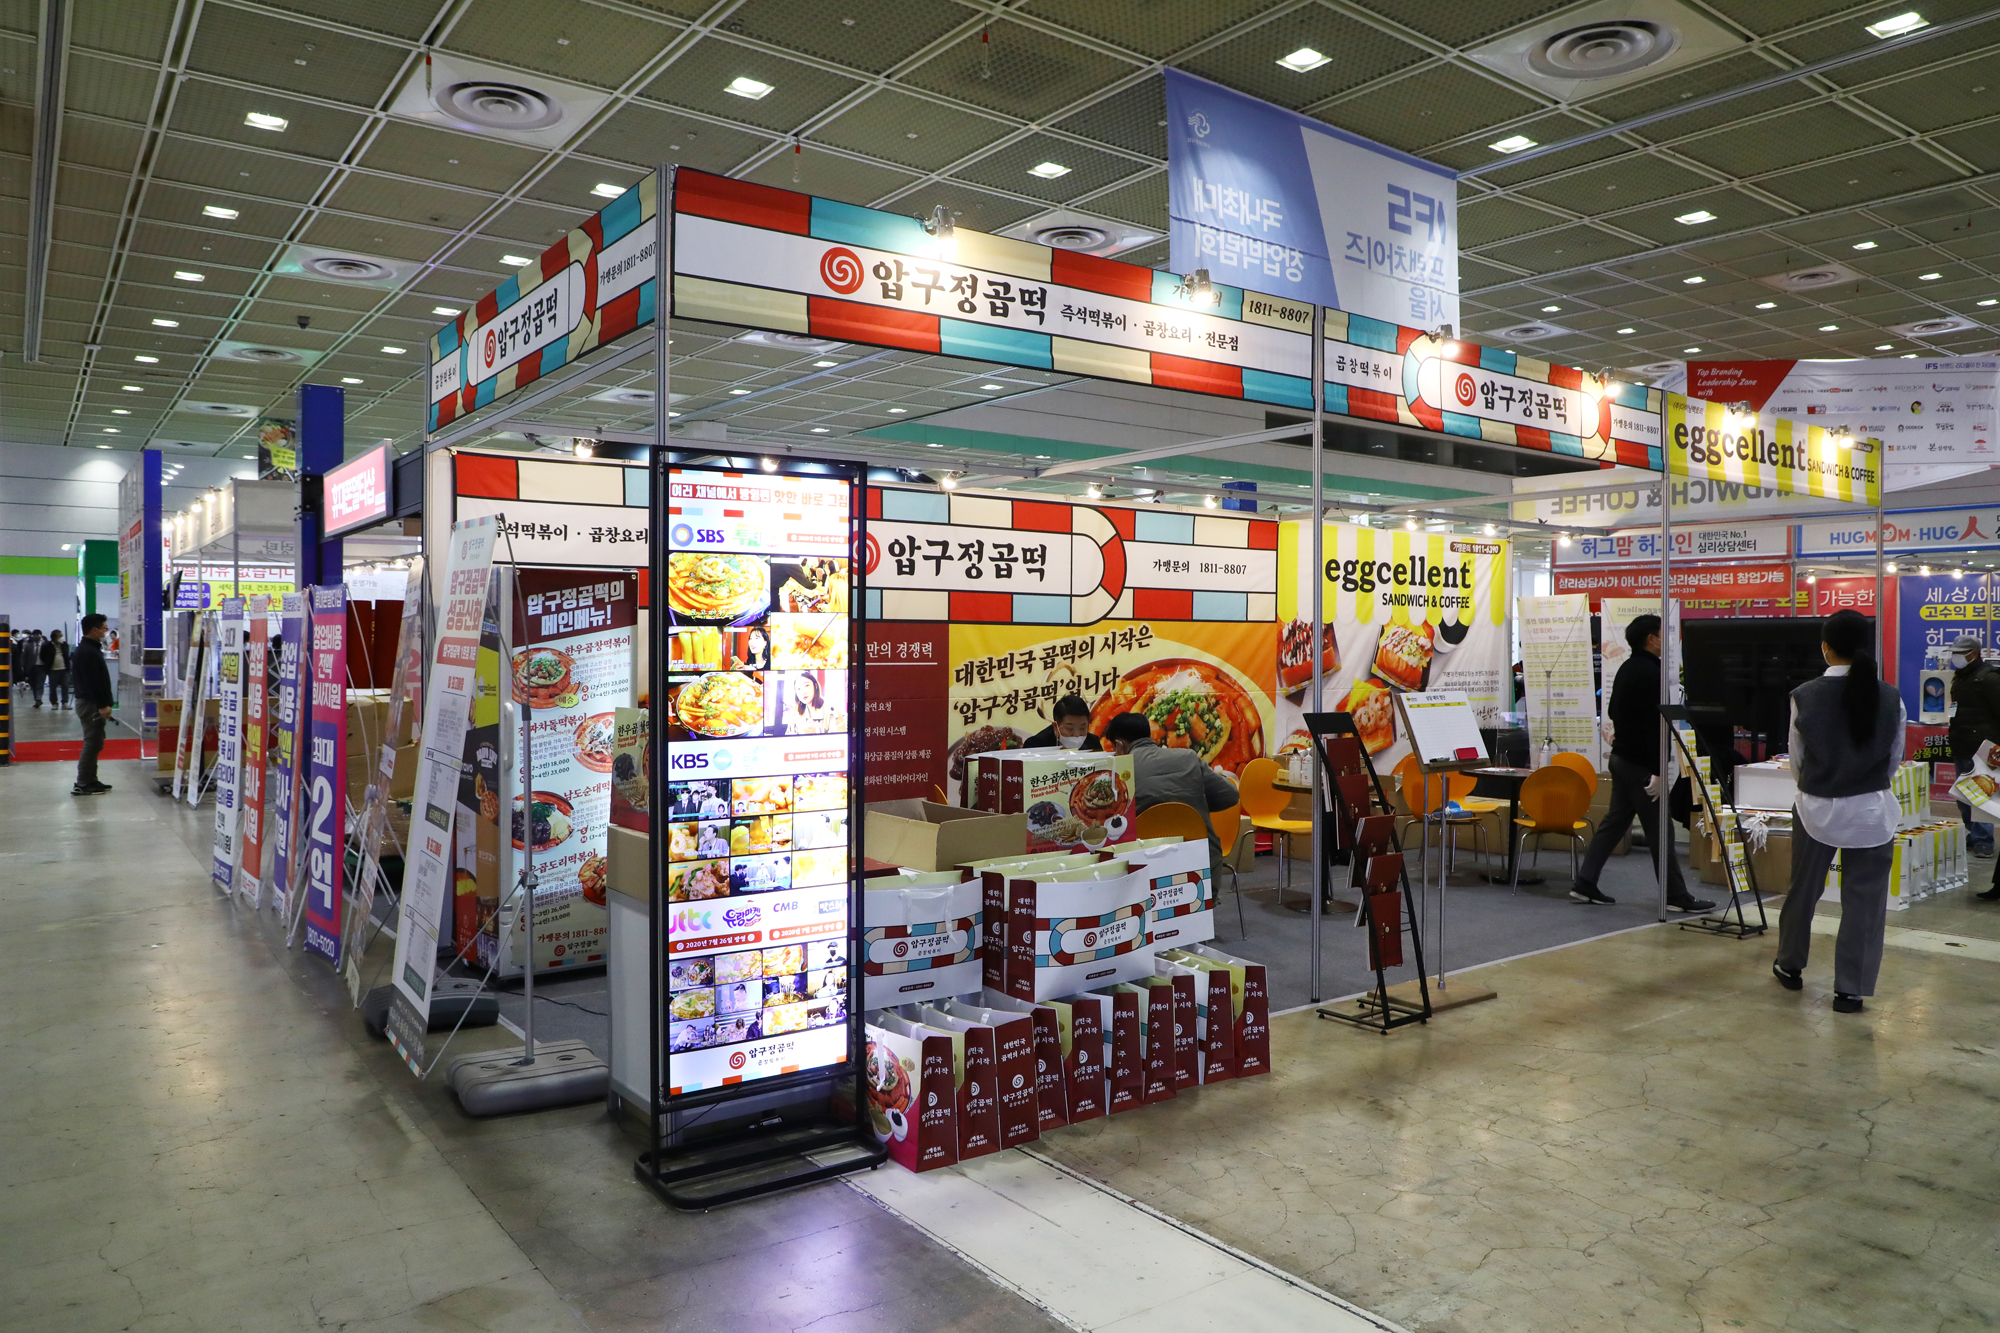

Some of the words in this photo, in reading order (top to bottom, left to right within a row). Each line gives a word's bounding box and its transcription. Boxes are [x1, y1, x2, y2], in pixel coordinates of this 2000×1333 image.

[599, 259, 623, 286] 가맹문의
[623, 241, 656, 272] 1811-8807
[872, 259, 1047, 326] 압구정곱떡
[1248, 300, 1310, 324] 1811-8807
[497, 287, 558, 359] 압구정곱떡
[1060, 304, 1127, 331] 즉석떡볶이
[1143, 319, 1192, 343] 곱창요리
[1205, 331, 1239, 352] 전문점
[1697, 368, 1710, 377] Top
[1710, 368, 1743, 377] Branding
[1697, 378, 1738, 388] Leadership
[1738, 379, 1757, 387] Zone
[1697, 388, 1714, 396] with
[1480, 379, 1568, 424] 압구정곱떡
[1612, 418, 1633, 432] 가맹문의
[1633, 419, 1660, 436] 1811-8807
[1674, 422, 1806, 472] eggcellent
[1808, 458, 1844, 477] SANDWICH
[1845, 467, 1850, 478] &
[1851, 467, 1875, 483] COFFEE
[331, 467, 376, 519] 휴대폰멀티샵
[671, 484, 693, 498] 여러
[695, 484, 737, 500] 채널에서
[774, 489, 797, 504] 핫한
[801, 492, 824, 506] 바로
[827, 494, 848, 508] 그집
[588, 526, 649, 545] 곱창요리
[696, 529, 725, 543] SBS
[1698, 531, 1729, 540] 대한민국
[1729, 530, 1747, 539] No.1
[1581, 535, 1634, 559] 허그맘
[1698, 540, 1757, 554] 심리상담센터
[888, 535, 1047, 582] 압구정곱떡
[1152, 559, 1190, 574] 가맹문의
[1199, 562, 1247, 575] 1811-8807
[449, 568, 488, 596] 압구정곱떡
[1325, 555, 1471, 593] eggcellent
[1558, 576, 1619, 589] 심리상담사가
[1621, 574, 1662, 587] 아니어도
[1737, 571, 1785, 584] 창업가능
[527, 580, 625, 616] 압구정곱떡의
[1382, 593, 1430, 608] SANDWICH
[1431, 596, 1438, 608] &
[1439, 596, 1470, 609] COFFEE
[1819, 588, 1875, 607] 가능한
[446, 599, 483, 632] 성공신화
[541, 604, 612, 636] 메인메뉴!
[1925, 606, 1967, 618] 고수익
[314, 624, 343, 650] 창업비용
[564, 635, 631, 657] 한우곱창떡볶이
[896, 641, 933, 659] 경쟁력
[954, 651, 1036, 686] 대한민국
[1039, 636, 1095, 672] 곱떡의
[1098, 625, 1153, 655] 시작은
[250, 641, 265, 678] 창업
[281, 641, 298, 680] 창업
[318, 653, 334, 679] 전액
[611, 678, 629, 688] 23,000
[611, 686, 629, 695] 29,000
[279, 685, 295, 724] 비용
[312, 683, 342, 710] 회사지원
[878, 702, 892, 712] 요청
[872, 727, 886, 737] 지원
[886, 726, 907, 736] 시스템
[313, 737, 335, 767] 최대
[671, 753, 709, 769] KBS
[883, 750, 904, 761] 품질의
[904, 749, 918, 760] 상품
[918, 749, 932, 760] 제공
[1913, 747, 1942, 759] 상품이
[551, 758, 570, 768] 18,000
[551, 767, 570, 776] 23,000
[883, 773, 929, 785] 인테리어디자인
[1030, 765, 1096, 788] 한우곱창떡볶이
[563, 781, 611, 801] 남도순대떡
[311, 776, 333, 911] 2억
[1157, 887, 1184, 900] 압구정곱떡
[551, 903, 571, 914] 26,000
[773, 901, 799, 912] CMB
[551, 911, 571, 923] 33,000
[537, 931, 570, 943] 가맹문의
[781, 928, 801, 937] 2020년
[1098, 922, 1127, 939] 압구정곱떡
[306, 924, 335, 958] 1800-5020
[567, 940, 599, 950] 압구정곱떡
[686, 940, 708, 949] 2020년
[720, 937, 733, 945] 26일
[734, 934, 746, 943] 방영
[911, 935, 950, 949] 압구정곱떡
[1003, 1038, 1026, 1050] 대한민국
[1042, 1036, 1055, 1044] 시작
[749, 1041, 795, 1059] 압구정곱떡
[1001, 1050, 1018, 1062] 곱떡의
[1020, 1047, 1031, 1056] 시작
[934, 1067, 949, 1075] 시작
[1002, 1086, 1034, 1103] 압구정곱떡
